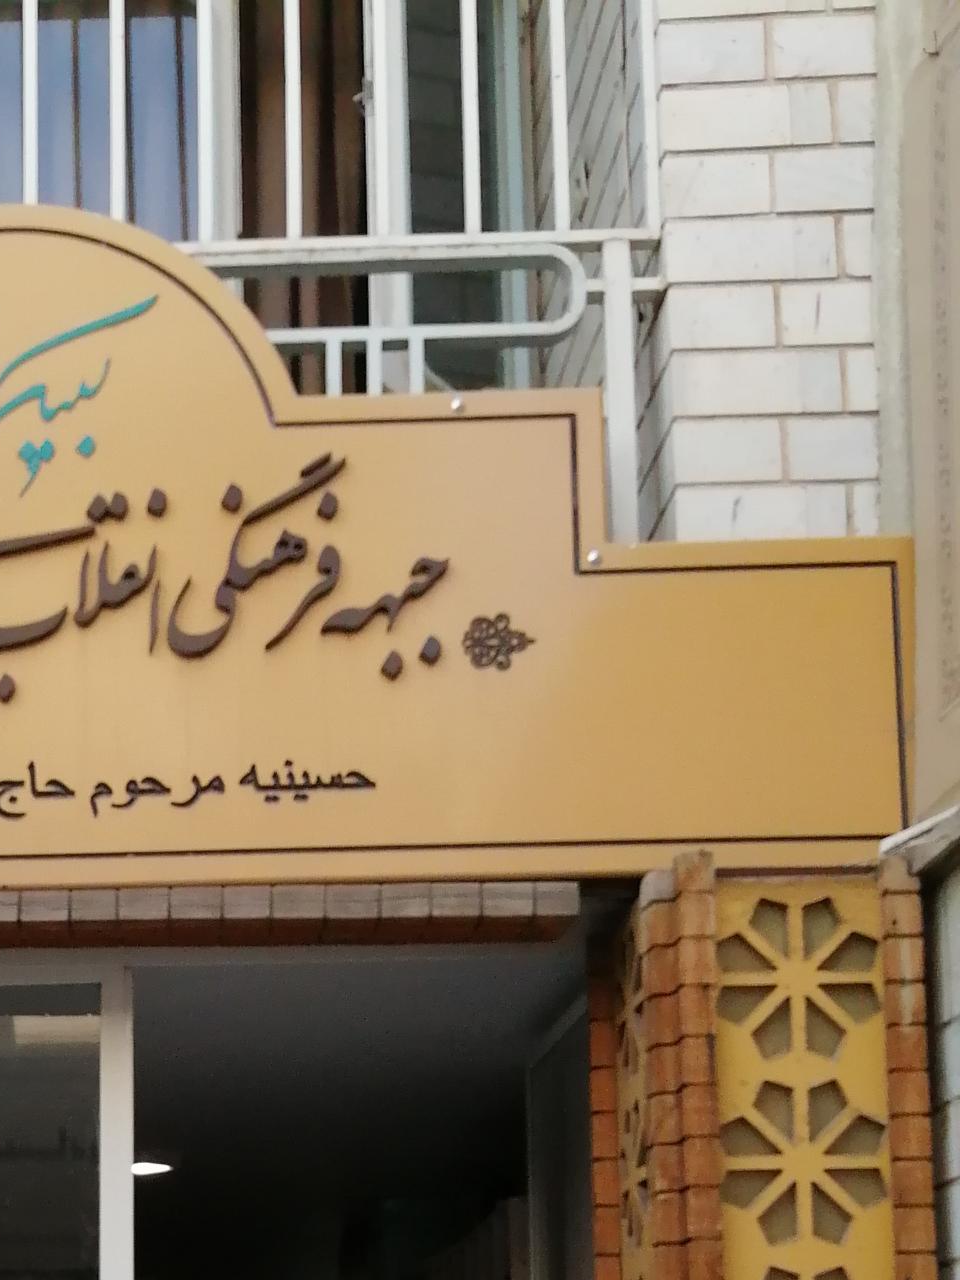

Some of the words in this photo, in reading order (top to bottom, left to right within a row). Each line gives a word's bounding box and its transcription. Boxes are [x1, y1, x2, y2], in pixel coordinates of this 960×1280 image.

[166, 451, 347, 659] فرهنگی
[320, 556, 450, 681] جبهه
[89, 774, 226, 818] مرحوم
[237, 759, 377, 804] حسینیه
